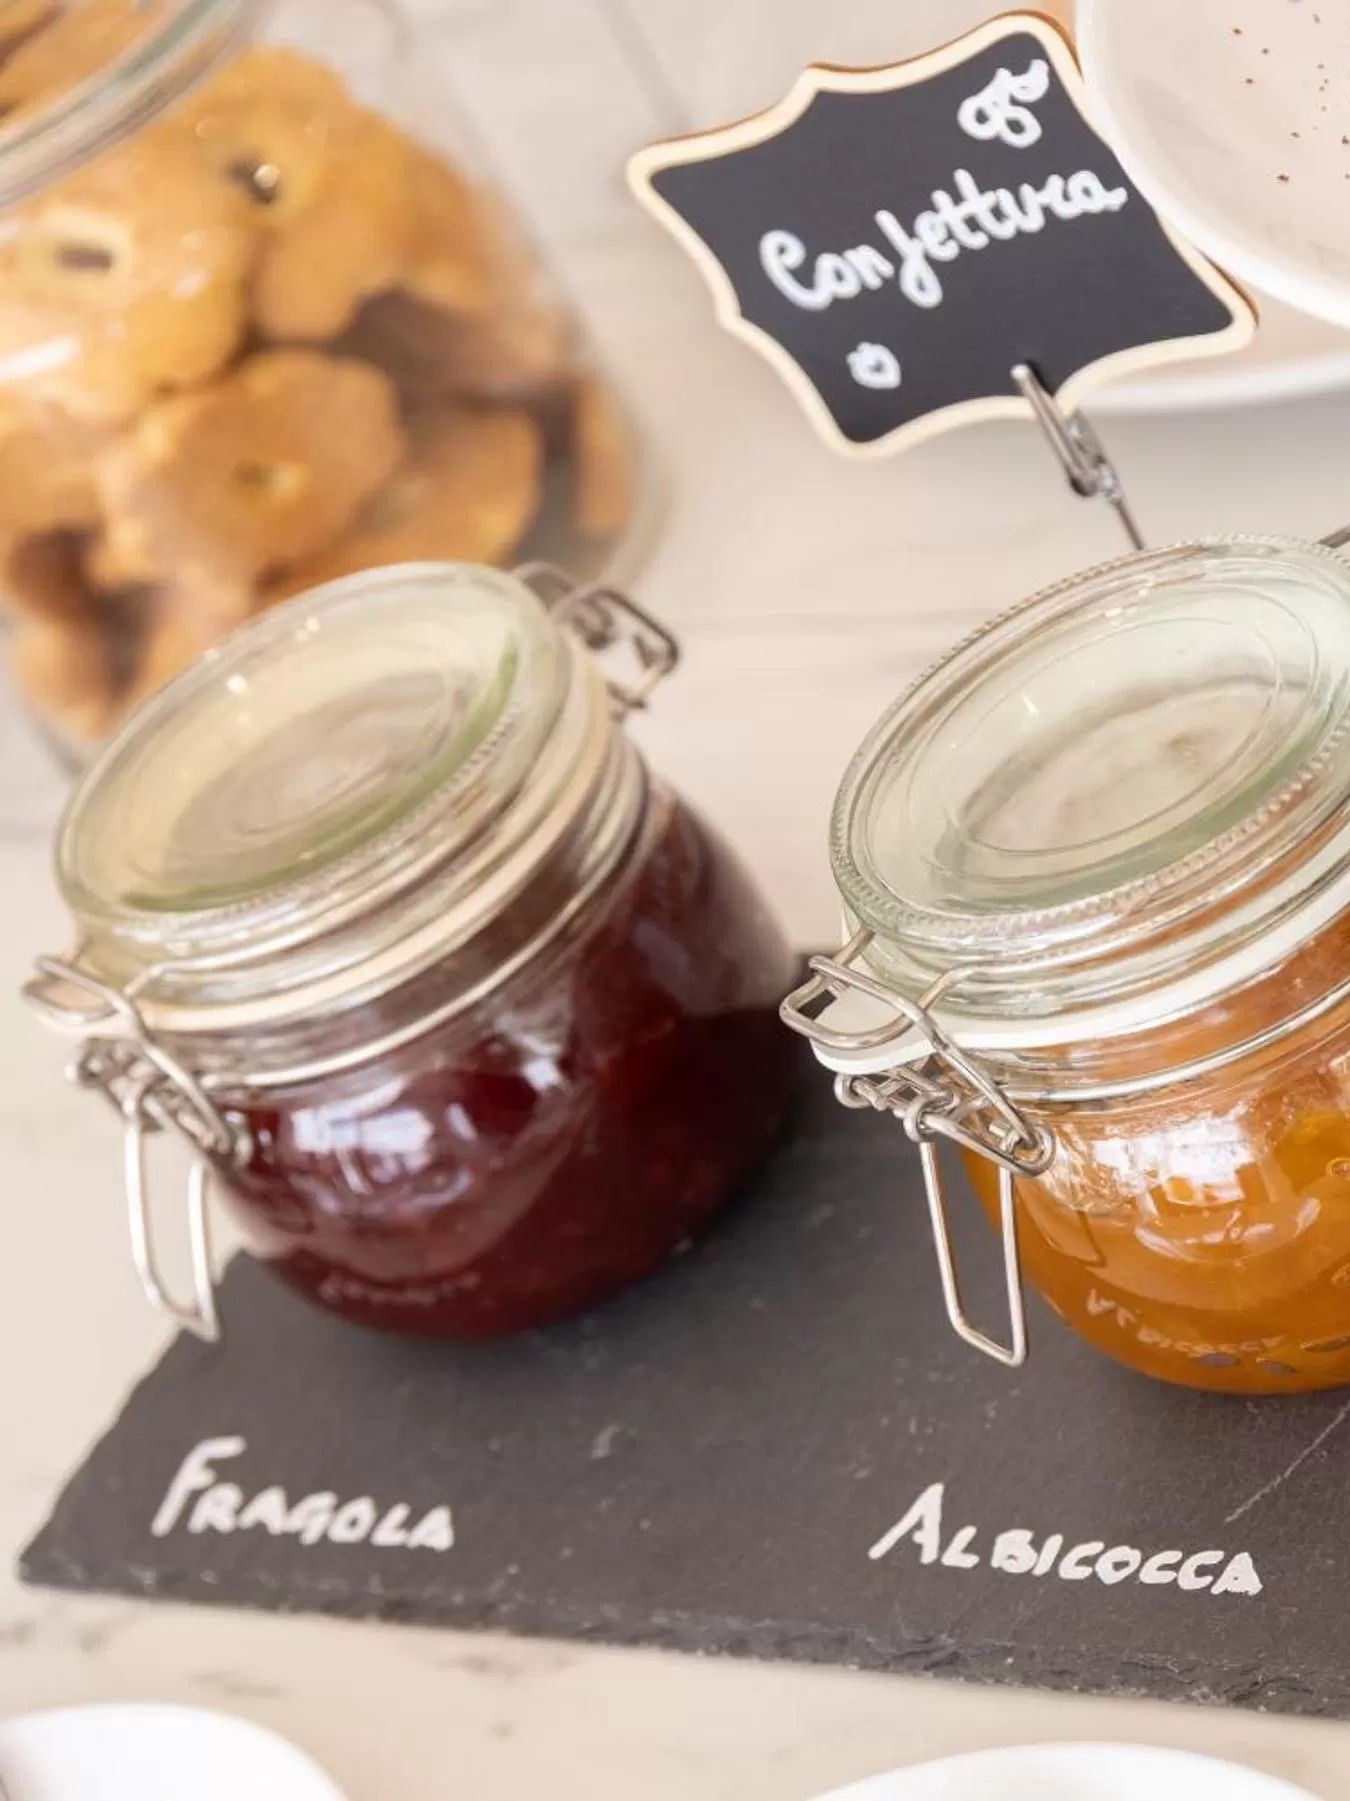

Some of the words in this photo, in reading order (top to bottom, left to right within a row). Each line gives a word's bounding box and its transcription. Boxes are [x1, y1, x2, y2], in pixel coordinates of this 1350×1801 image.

[759, 168, 1128, 309] Confettura
[151, 1436, 455, 1551] FRAGOLA
[867, 1482, 1264, 1596] ALBICOCCA
